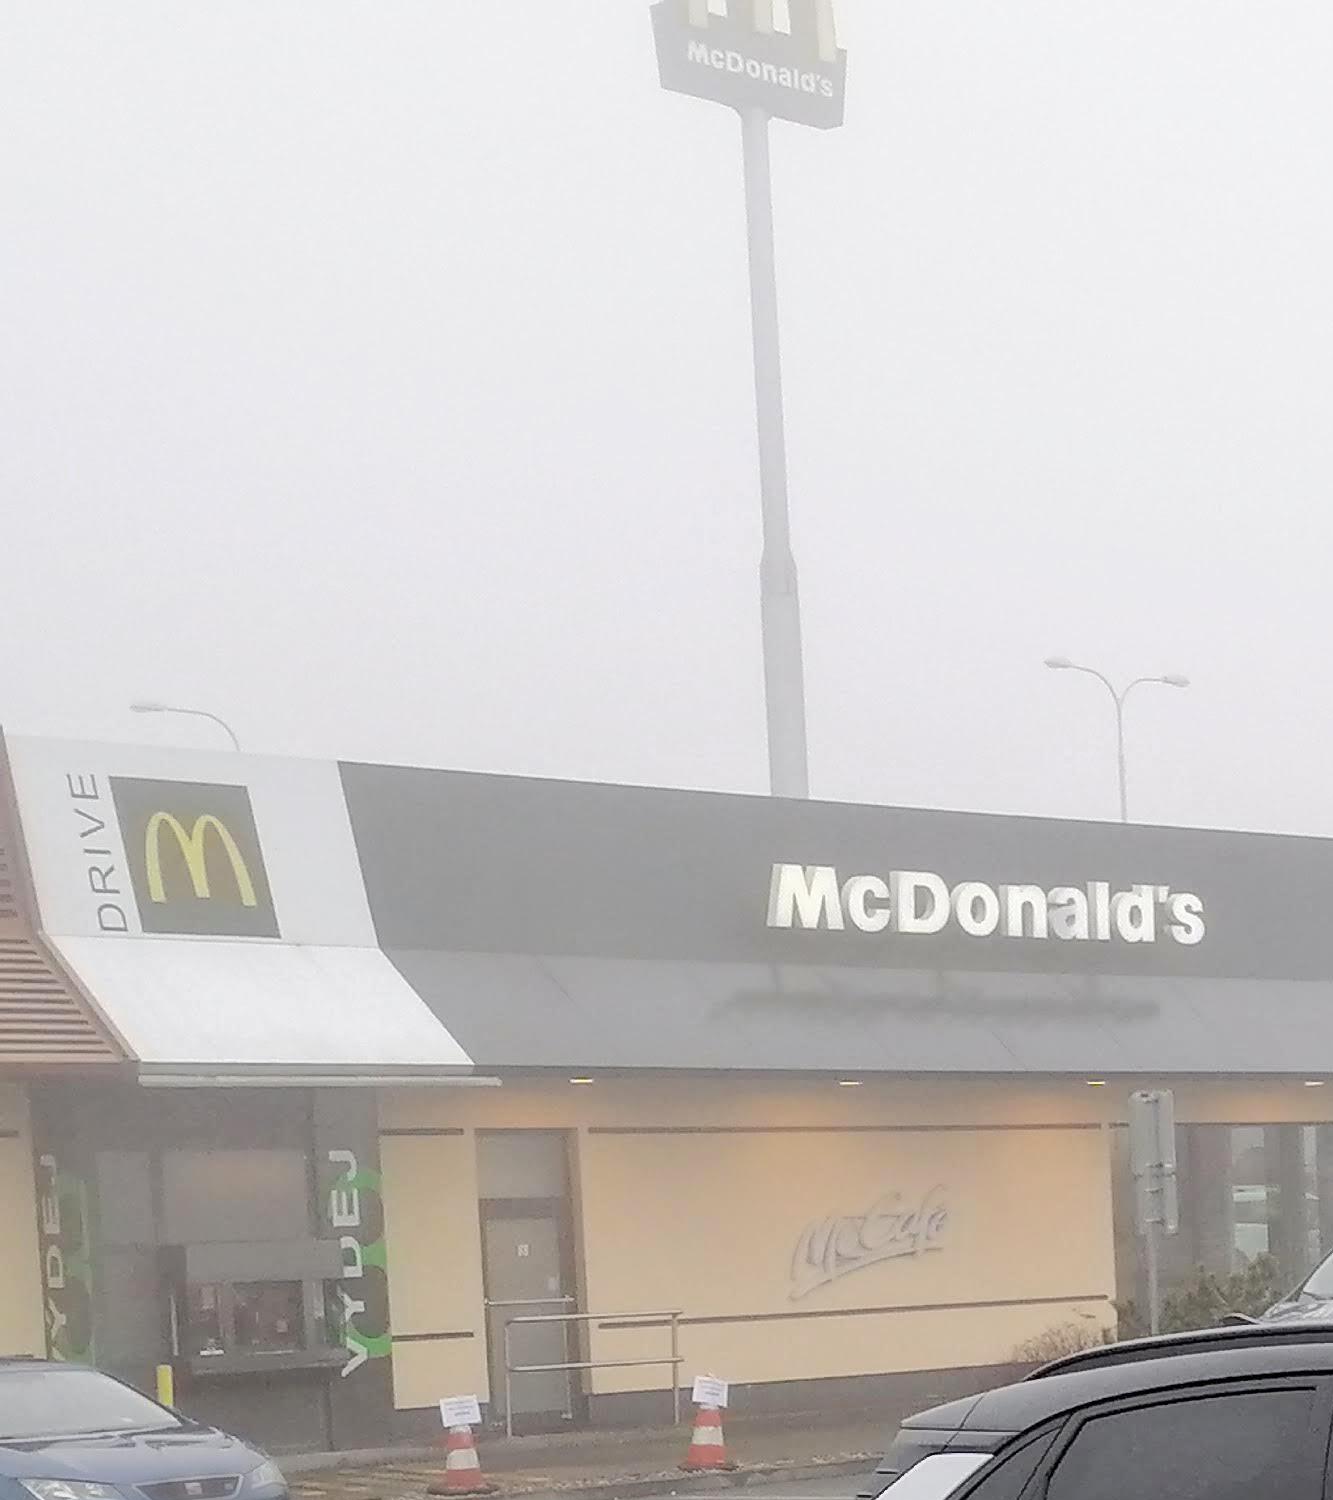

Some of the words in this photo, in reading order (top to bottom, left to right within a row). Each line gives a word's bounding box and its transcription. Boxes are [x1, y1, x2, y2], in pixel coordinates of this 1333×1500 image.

[686, 39, 834, 98] McDonald's
[66, 773, 129, 932] DRIVE
[766, 863, 1206, 946] McDonald's
